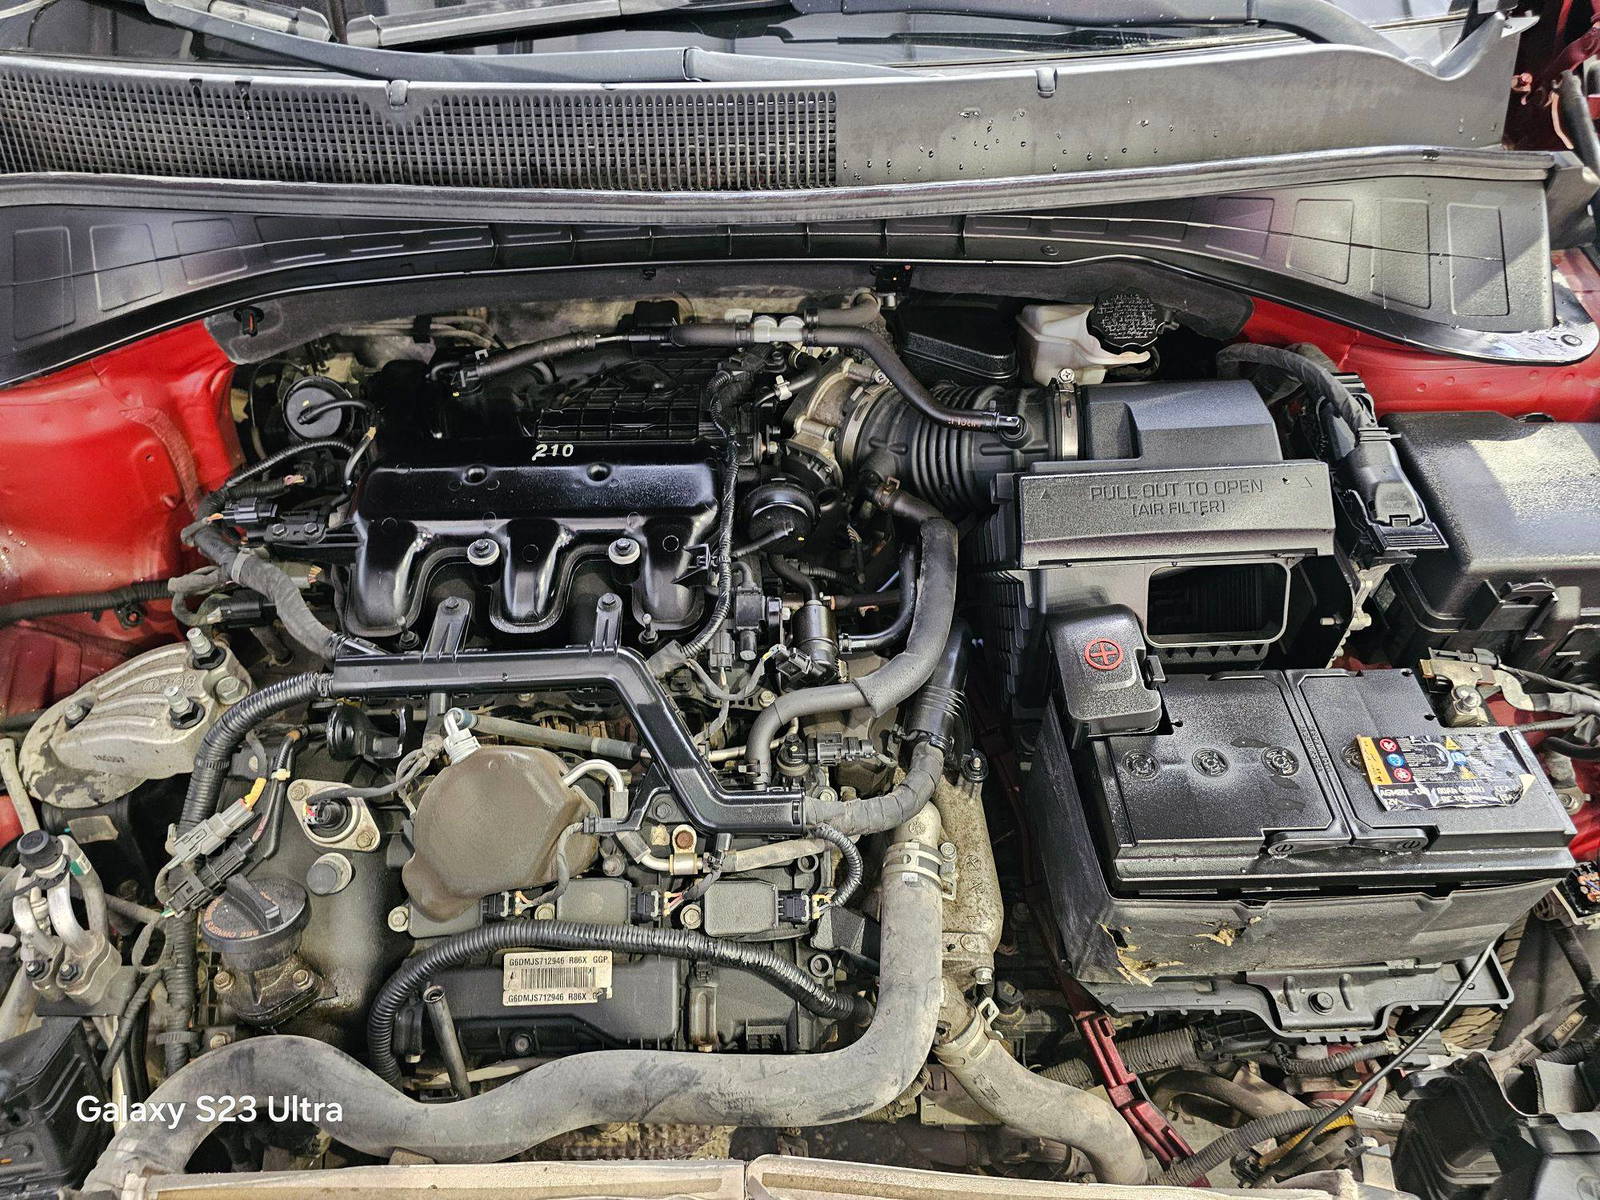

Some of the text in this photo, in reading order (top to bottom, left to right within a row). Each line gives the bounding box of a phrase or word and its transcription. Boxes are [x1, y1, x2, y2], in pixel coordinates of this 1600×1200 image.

[531, 443, 574, 461] 210
[1089, 479, 1263, 500] PULL OUT TO OPEN
[509, 957, 566, 967] G6DMJS712946
[592, 955, 608, 964] GGP
[508, 992, 564, 1003] G6DMJS712946
[568, 992, 587, 1001] R86X
